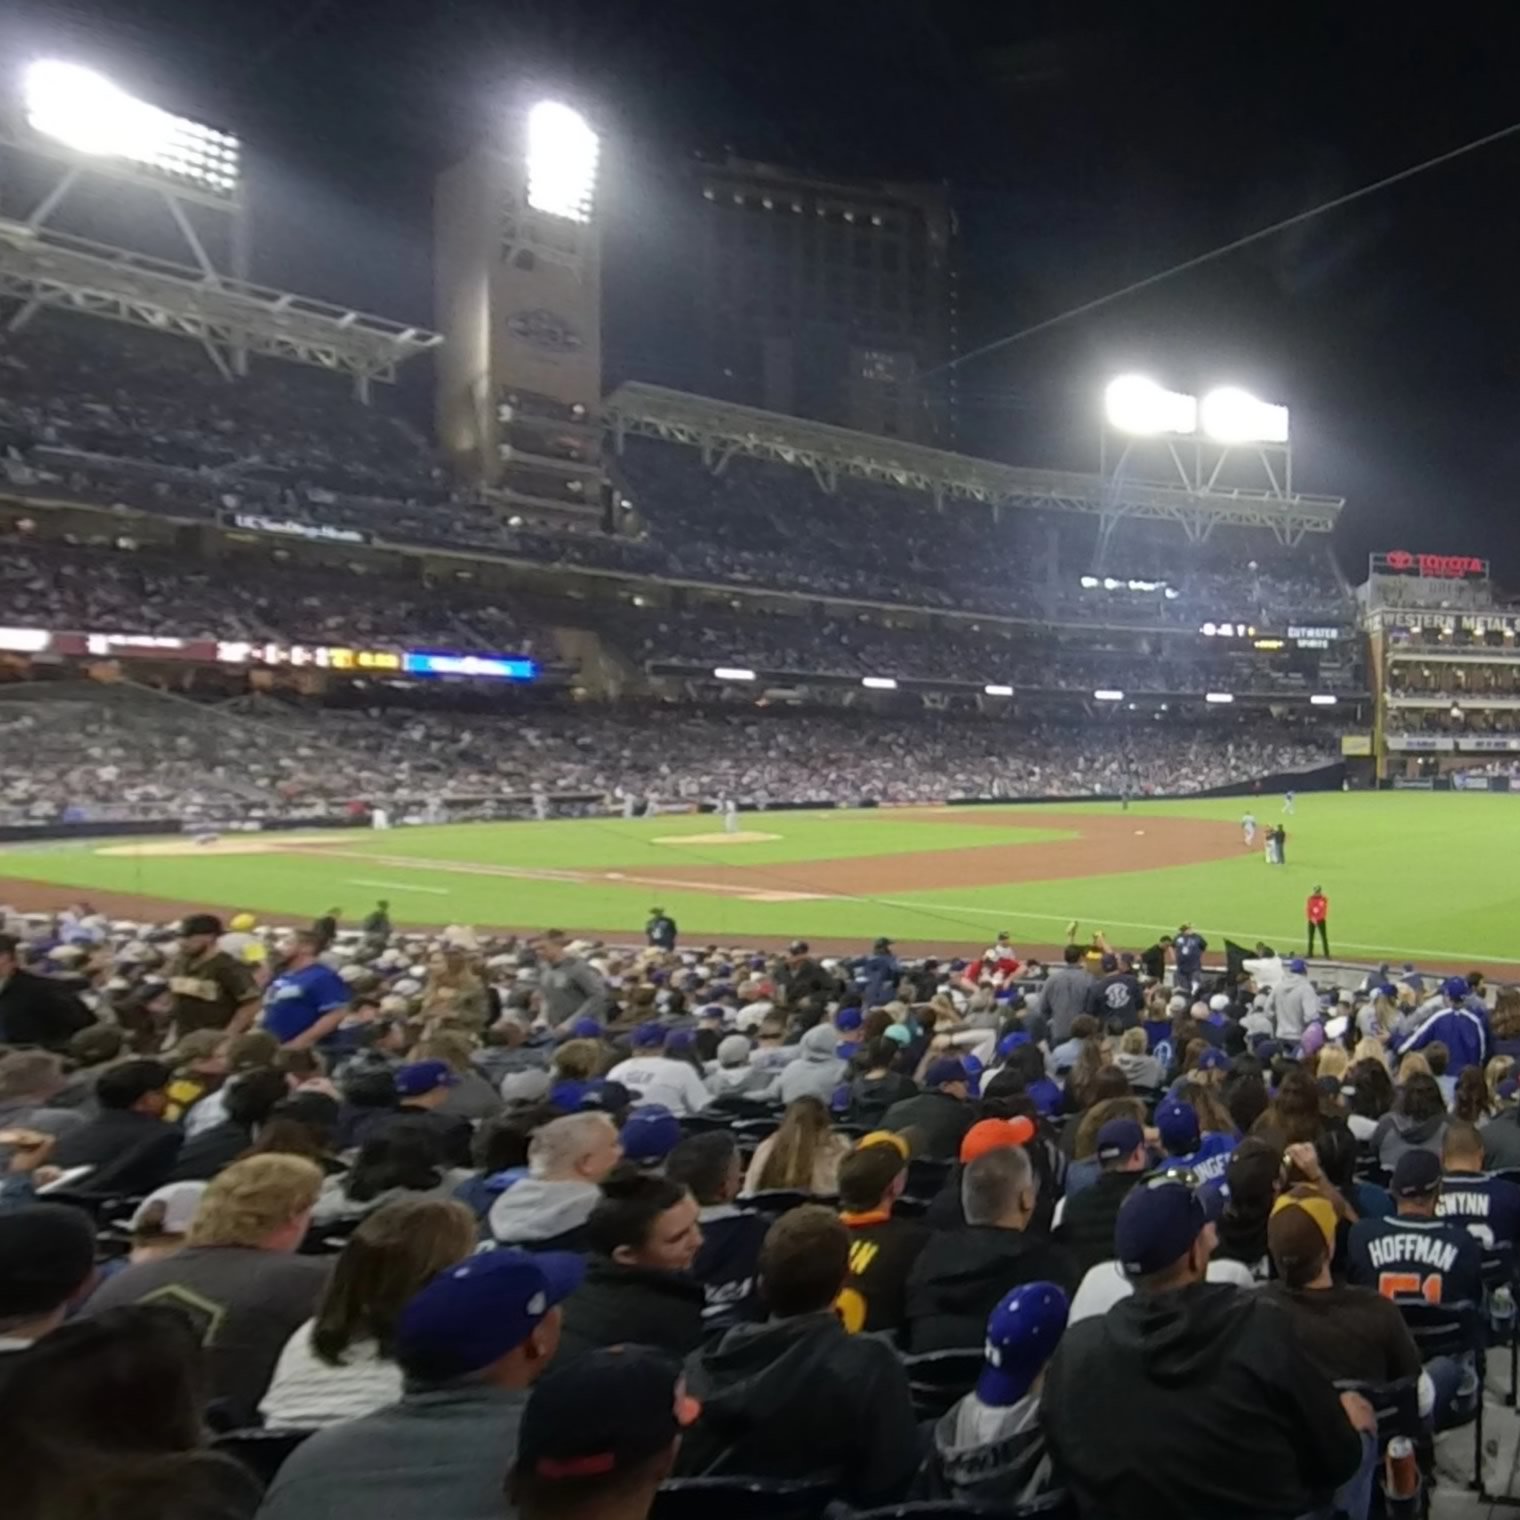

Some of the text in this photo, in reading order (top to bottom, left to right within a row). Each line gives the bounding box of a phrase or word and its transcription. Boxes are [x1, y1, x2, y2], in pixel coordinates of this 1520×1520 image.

[1418, 556, 1483, 572] TOYOTA
[1383, 612, 1455, 629] WESTERN
[1462, 616, 1509, 633] METAL
[1434, 1192, 1490, 1217] GWYNN
[1368, 1234, 1458, 1272] HOFFMAN
